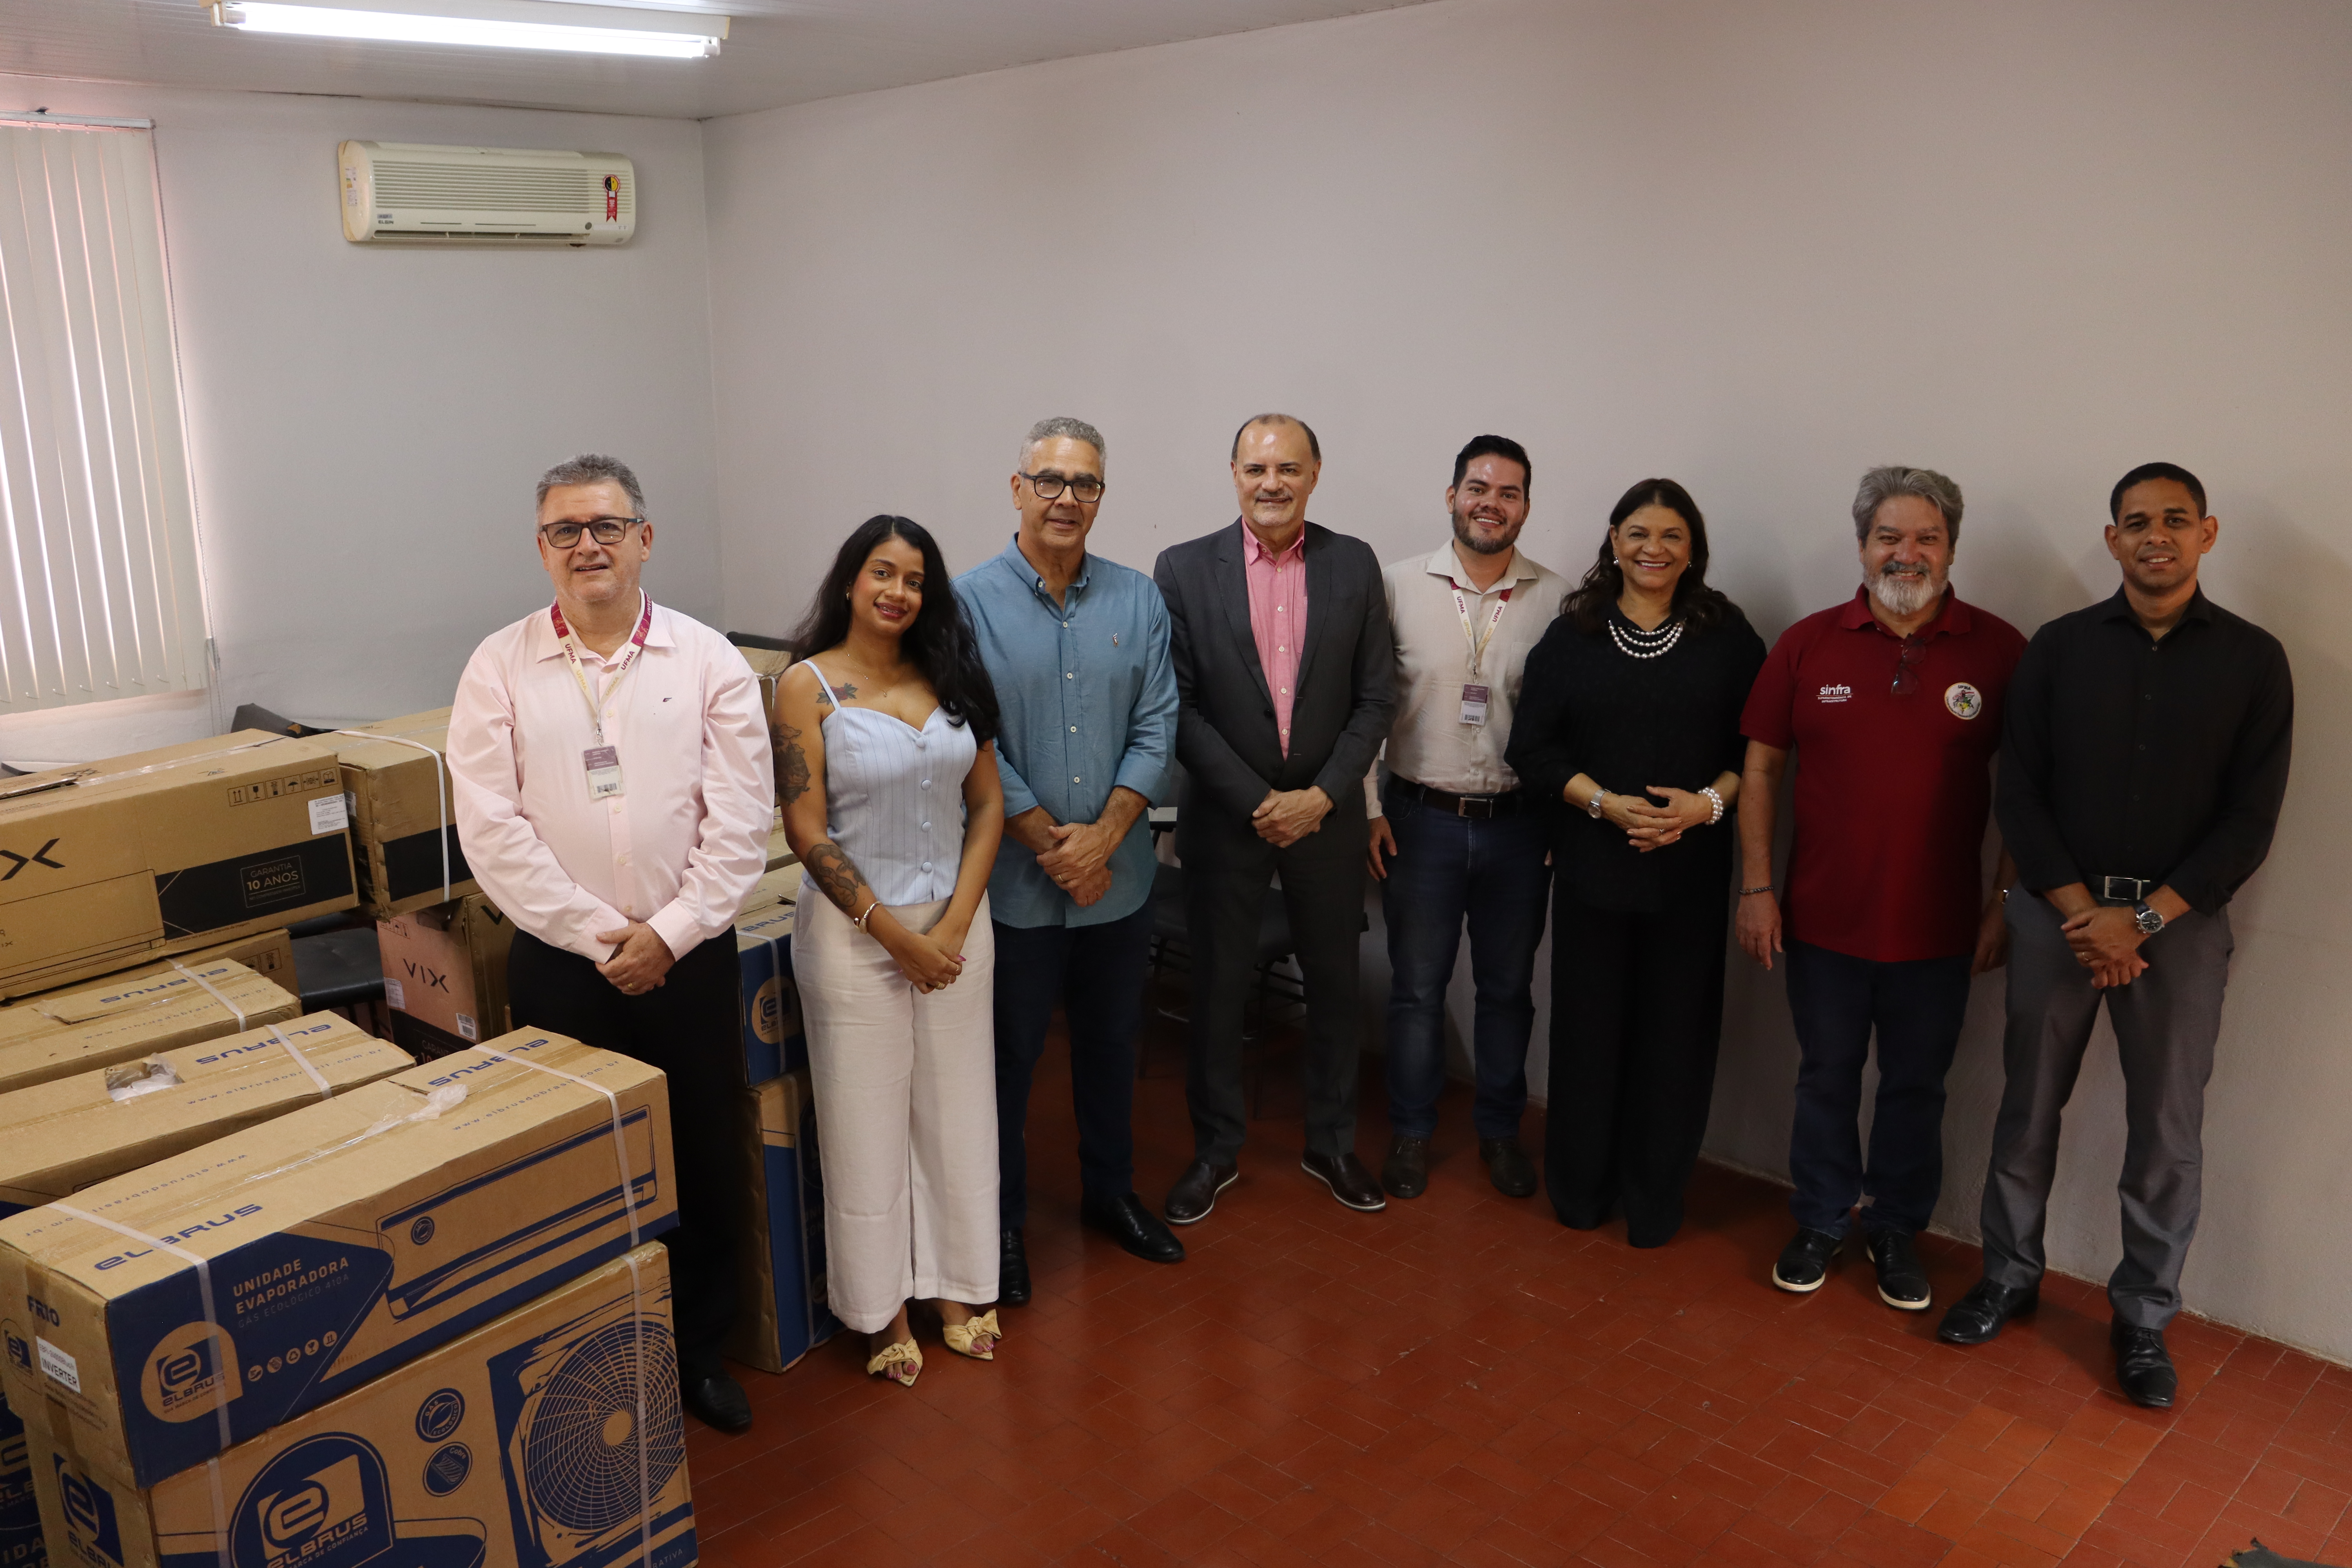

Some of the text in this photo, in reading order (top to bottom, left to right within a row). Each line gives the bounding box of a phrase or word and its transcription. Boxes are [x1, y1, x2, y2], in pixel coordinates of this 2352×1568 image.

[1492, 606, 1503, 622] UFMA
[1482, 628, 1492, 644] UFMA
[565, 643, 576, 664] UFMA
[621, 651, 635, 670] UFMA
[577, 670, 587, 690] UFMA
[606, 677, 619, 696] UFMA
[1820, 684, 1850, 695] sinfra
[250, 863, 293, 878] GARANTIA
[247, 871, 298, 891] 10 ANOS
[403, 958, 450, 993] VIX
[187, 1048, 382, 1105] www.elbrusdobrsil.com.br
[452, 1060, 619, 1131] www.elbrusdobrasilcom.br
[24, 1154, 247, 1237] www.elbrusdobrasilom.br
[233, 1258, 301, 1297] UNIDADE
[236, 1257, 349, 1314] EVAPORADORA
[325, 1274, 349, 1289] 410A
[27, 1294, 60, 1327] FRIO
[41, 1357, 77, 1388] INVERTER
[449, 1447, 466, 1459] Cobre
[316, 1546, 325, 1558] DE
[327, 1526, 368, 1552] CONFIANÇA
